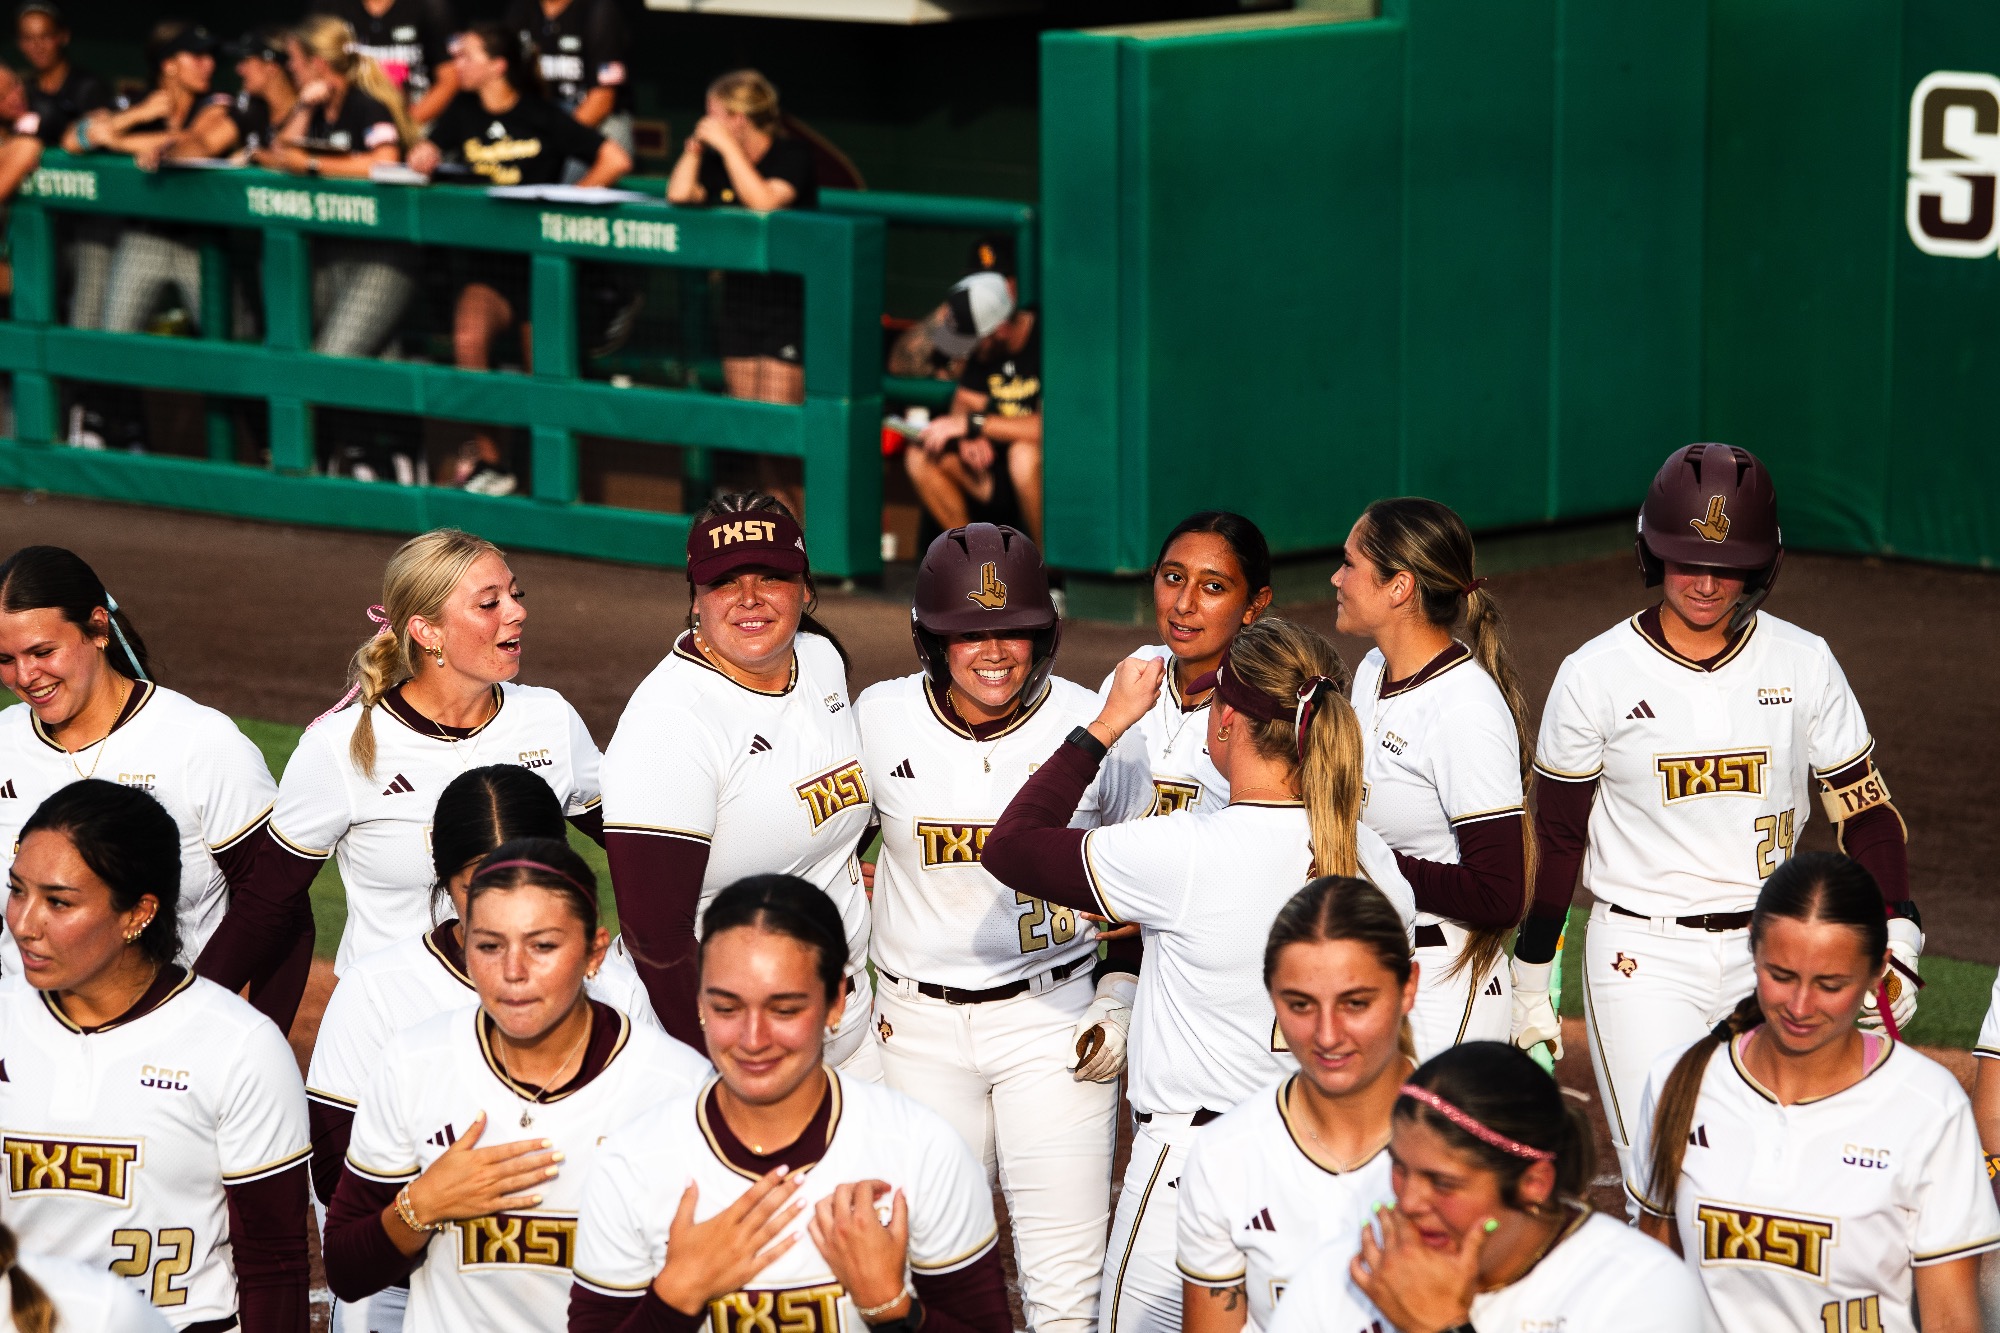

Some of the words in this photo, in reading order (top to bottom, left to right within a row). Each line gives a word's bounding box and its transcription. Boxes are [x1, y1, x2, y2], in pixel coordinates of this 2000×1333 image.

[247, 186, 312, 220] TEXAS
[315, 192, 378, 226] STATE
[540, 212, 609, 247] TEXAS
[612, 219, 679, 252] STATE
[708, 520, 776, 549] TXST
[1757, 686, 1793, 706] SBC
[799, 763, 870, 827] TXST
[1659, 754, 1765, 800] TXST
[1754, 807, 1796, 881] 24
[140, 1064, 190, 1092] SBC
[3, 1139, 136, 1200] TXST
[1842, 1143, 1891, 1170] SBC
[1699, 1207, 1831, 1275] TXST
[707, 1283, 845, 1333] TXST
